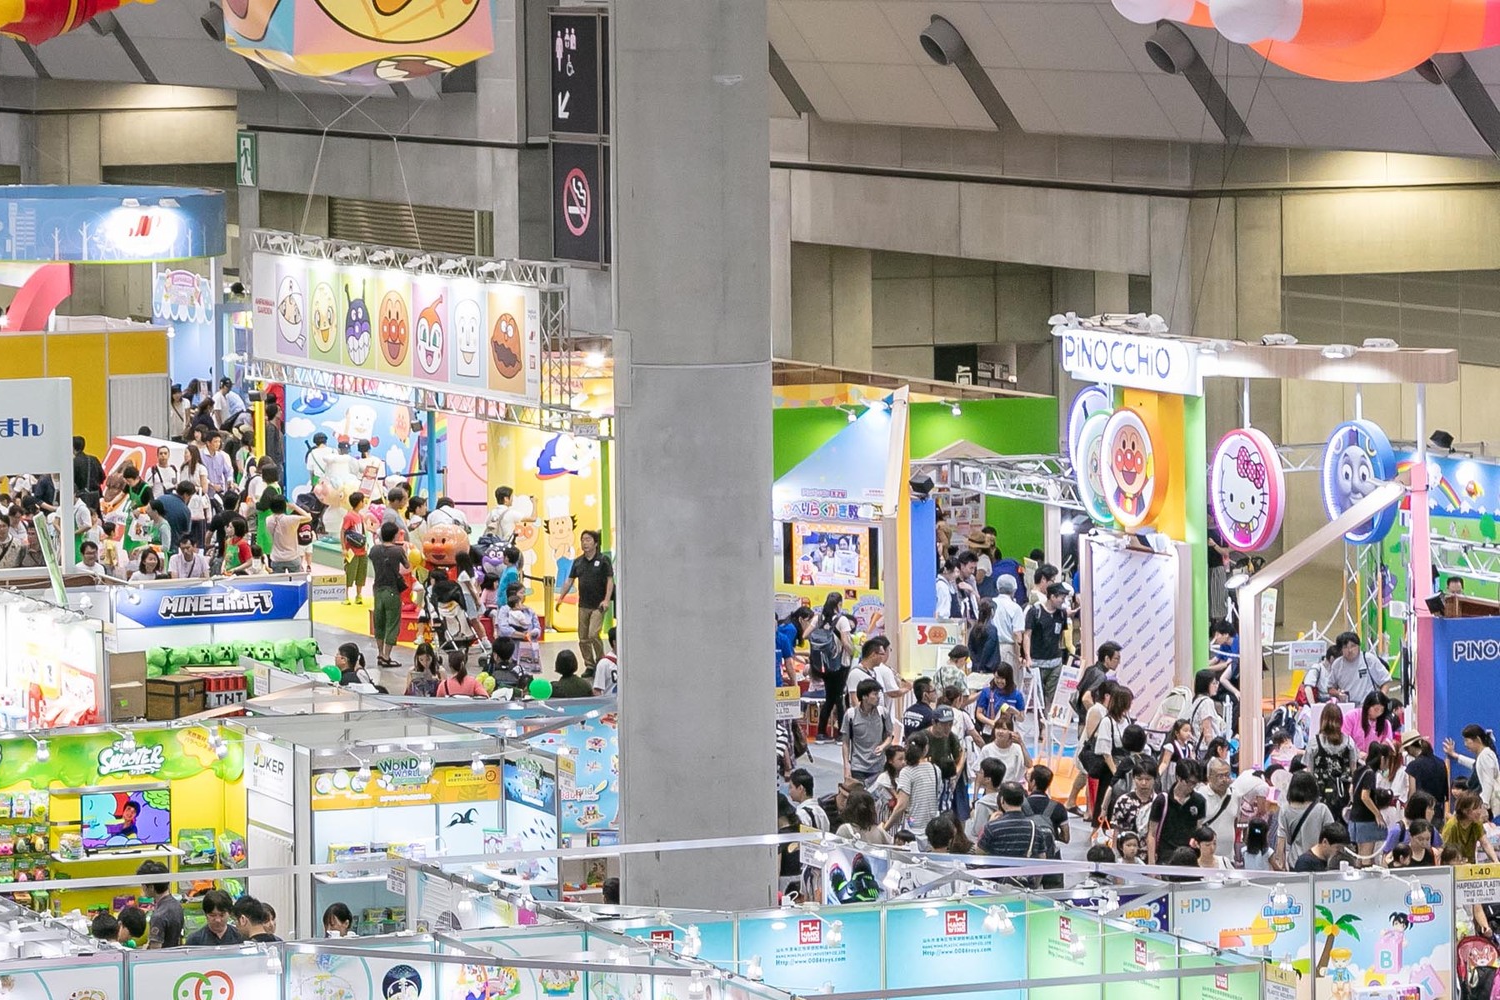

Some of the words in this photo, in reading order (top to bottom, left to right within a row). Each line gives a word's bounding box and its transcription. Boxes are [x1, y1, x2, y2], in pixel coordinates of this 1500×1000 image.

[158, 590, 274, 620] MINECRAFT
[1453, 640, 1500, 662] PINO
[215, 692, 243, 706] TNT
[1470, 868, 1491, 876] 1-40
[1320, 888, 1351, 904] HPD
[1181, 898, 1211, 914] HPD
[1380, 950, 1392, 969] B
